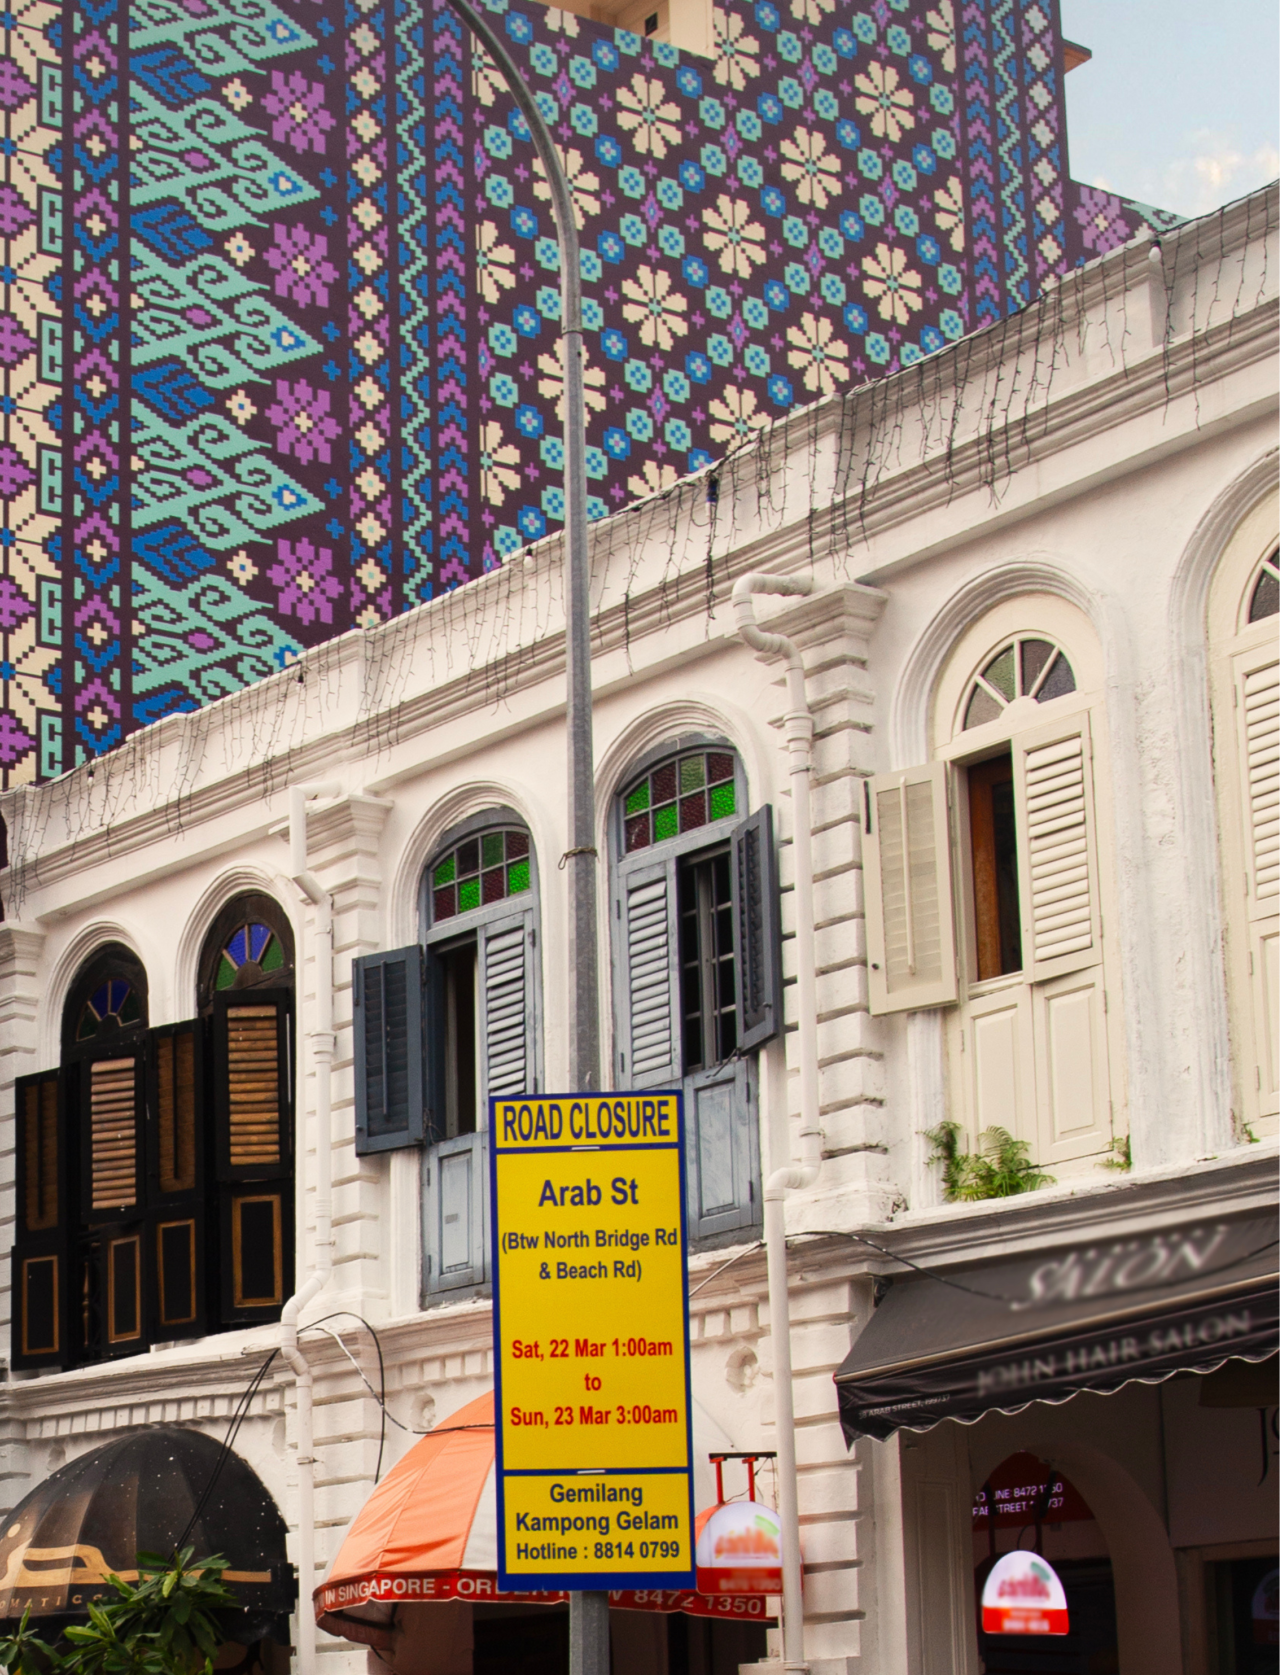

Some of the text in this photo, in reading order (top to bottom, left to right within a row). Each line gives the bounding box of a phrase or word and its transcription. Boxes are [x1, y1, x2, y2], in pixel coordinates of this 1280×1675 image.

[503, 1100, 670, 1141] ROAD CLOSURE
[538, 1176, 639, 1207] Arab St
[501, 1228, 678, 1254] (Btw North Bridge Rd
[539, 1260, 642, 1282] & Beach Rd)
[512, 1337, 673, 1361] Sat, 22 Mar 1:00am
[977, 1310, 1250, 1397] JOHN HAIR SALON
[584, 1373, 602, 1391] to
[510, 1405, 678, 1429] Sun, 23 Mar 3:00am
[549, 1483, 643, 1507] Gemilang
[1013, 1485, 1037, 1498] 8472
[516, 1511, 679, 1535] Kampong Gelam
[517, 1542, 577, 1560] Hotline
[594, 1542, 634, 1560] 8814
[639, 1541, 680, 1558] 0799
[325, 1587, 335, 1604] IN
[338, 1578, 435, 1602] SINGAPORE
[705, 1596, 762, 1614] 1350
